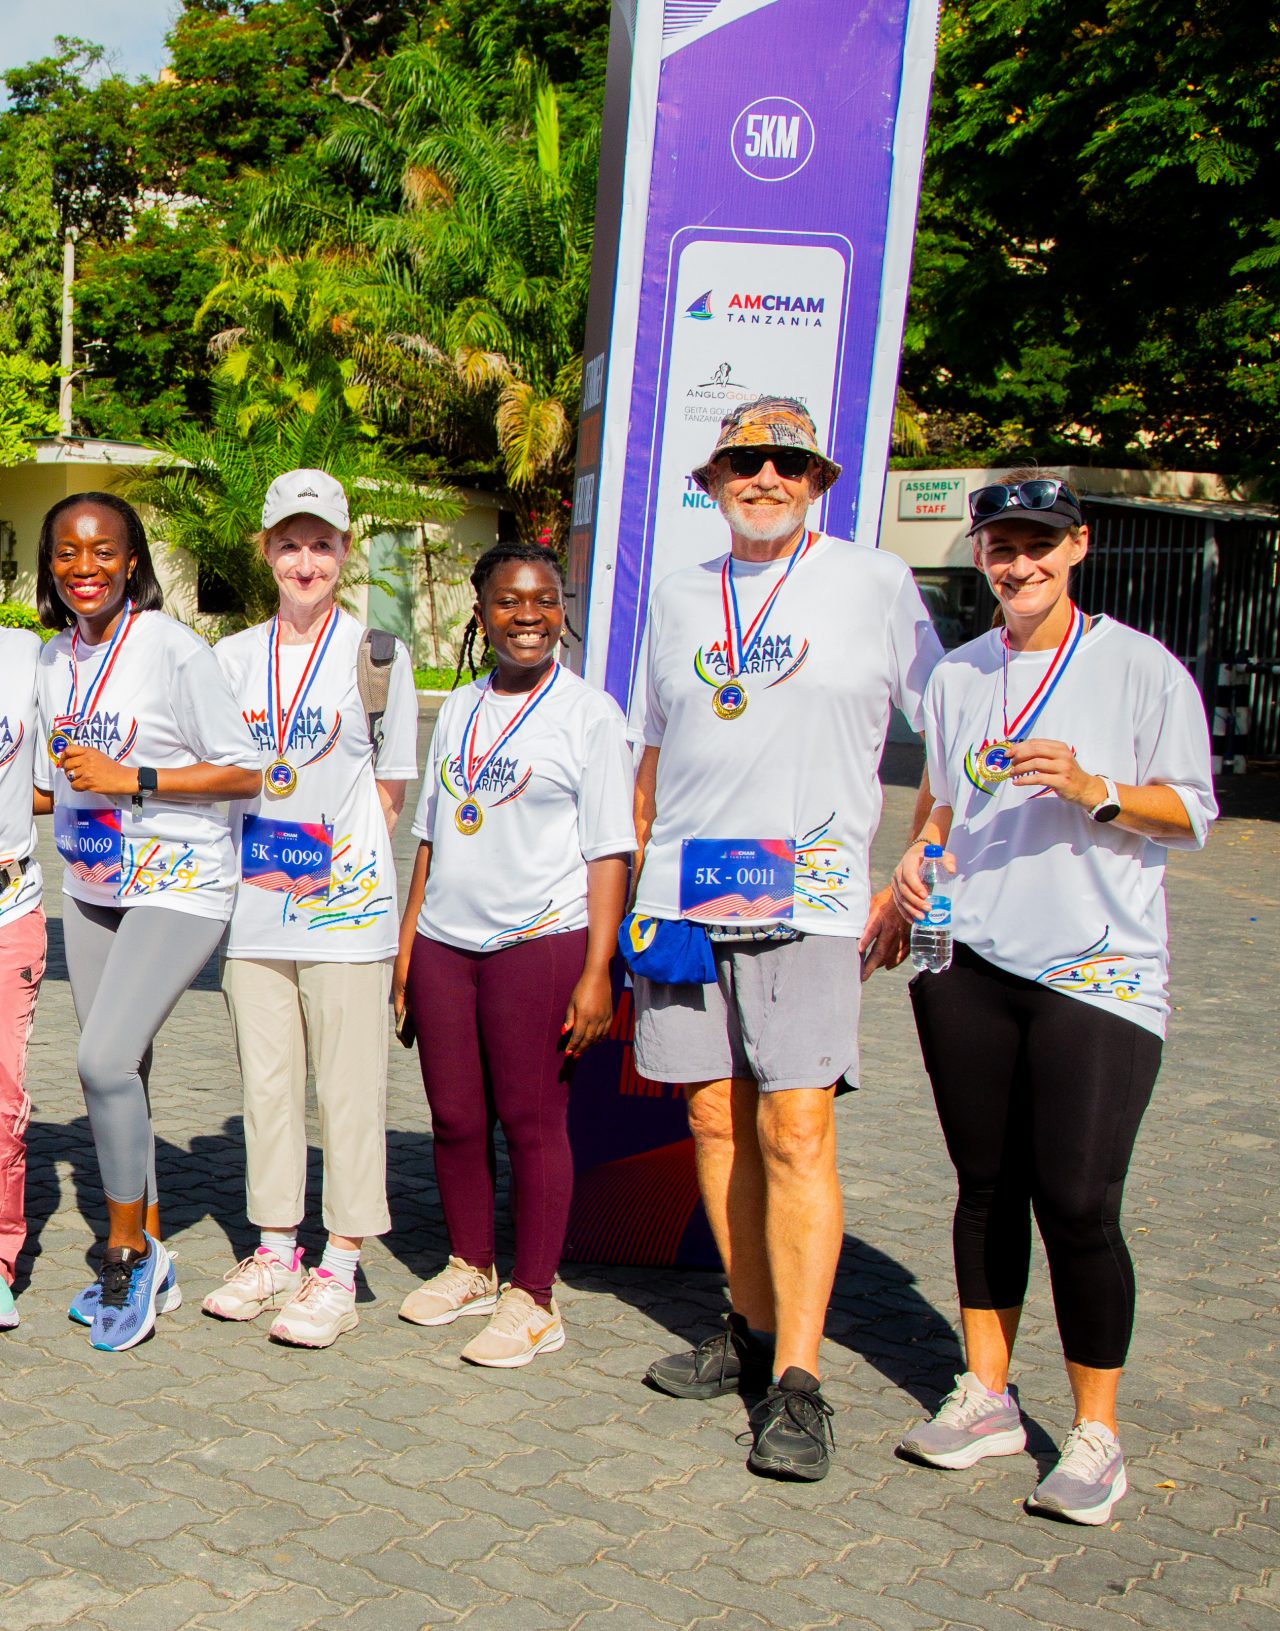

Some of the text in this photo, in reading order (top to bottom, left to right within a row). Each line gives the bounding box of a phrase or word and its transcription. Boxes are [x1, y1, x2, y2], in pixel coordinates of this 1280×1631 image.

[745, 114, 800, 159] 5KM
[728, 293, 825, 313] AMCHAM
[727, 313, 823, 327] TANZANIA
[684, 406, 708, 415] GEITA
[906, 481, 960, 491] ASSEMBLY
[916, 492, 948, 501] POINT
[915, 504, 947, 514] STAFF
[60, 835, 74, 852] 5K
[79, 837, 113, 854] 0069
[251, 842, 271, 861] 5K
[281, 848, 323, 867] 0099
[694, 867, 722, 885] 5K
[736, 867, 776, 886] 0011
